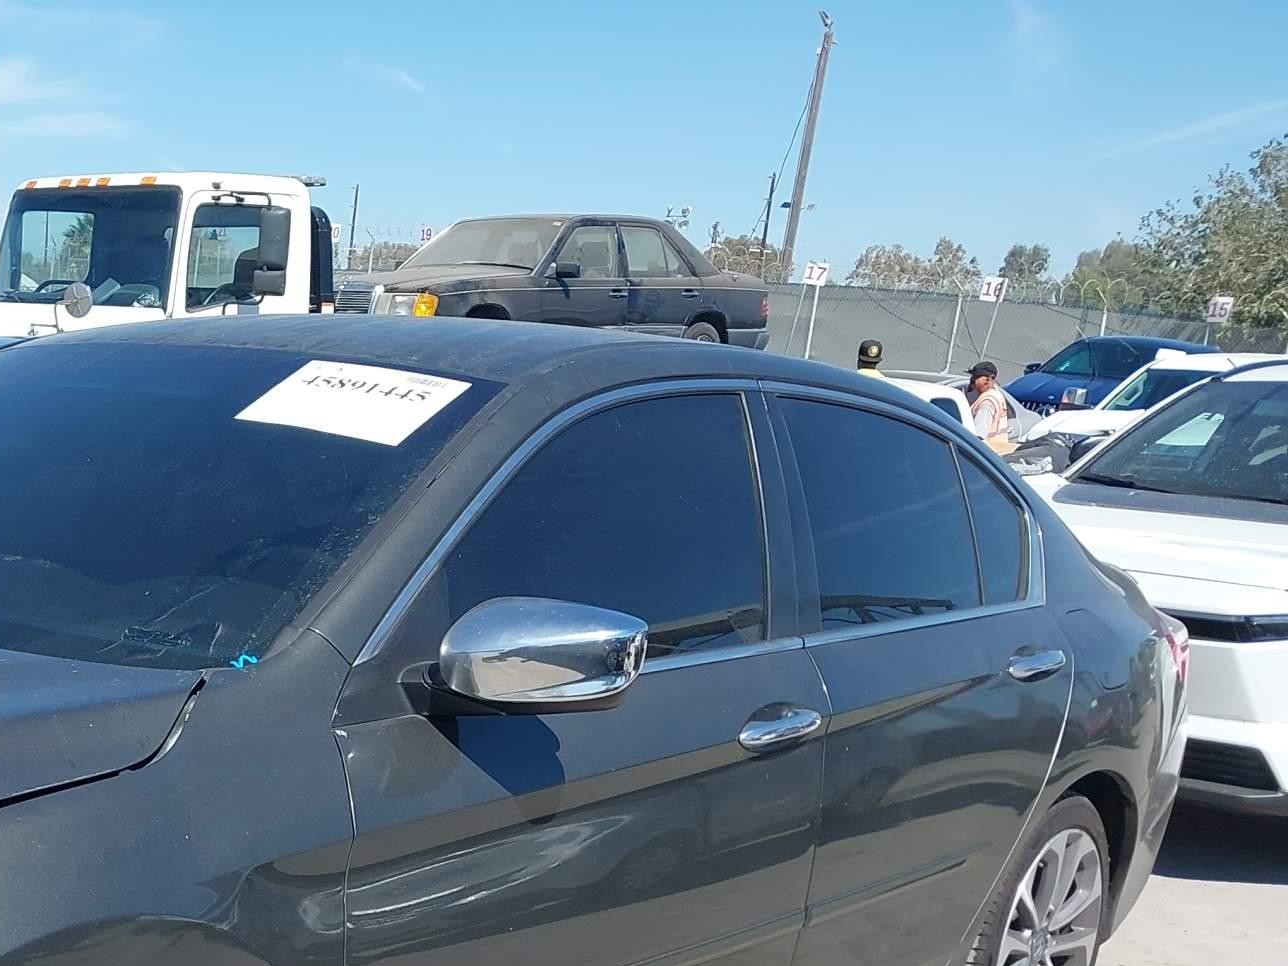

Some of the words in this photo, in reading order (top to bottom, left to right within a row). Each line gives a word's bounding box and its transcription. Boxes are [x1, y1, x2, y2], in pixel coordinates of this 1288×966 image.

[420, 228, 432, 241] 19
[805, 266, 828, 281] 17
[983, 282, 1001, 297] 16
[1209, 302, 1230, 318] 15
